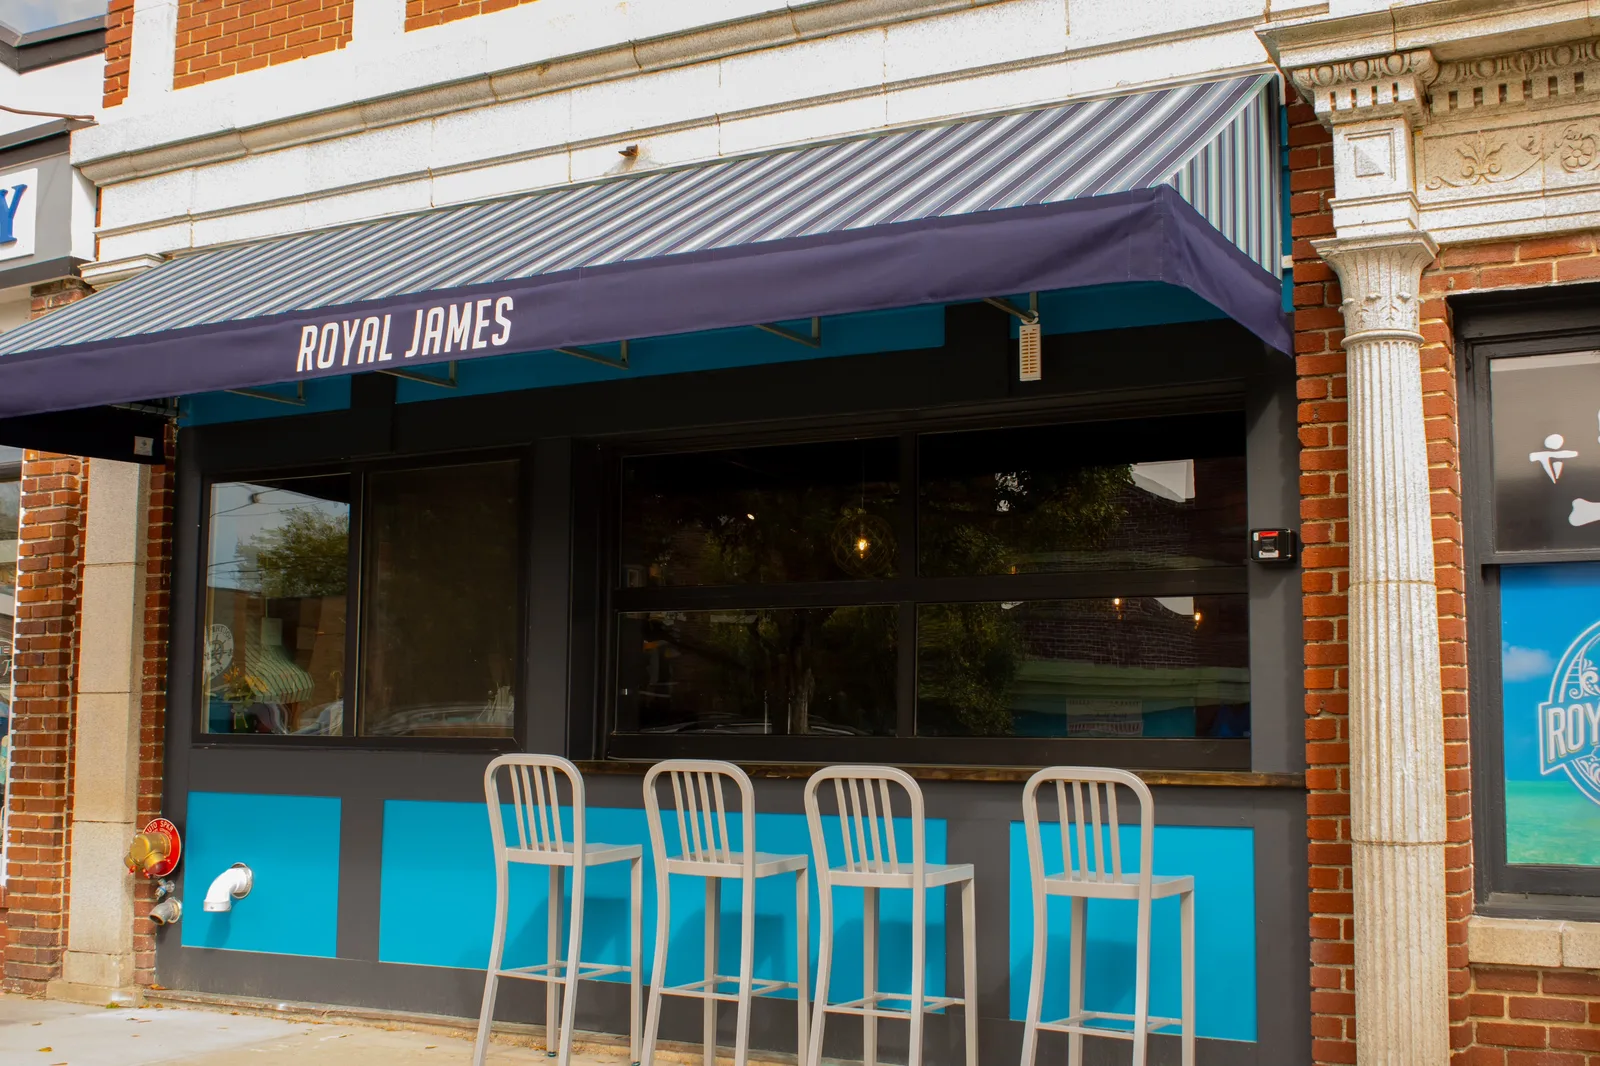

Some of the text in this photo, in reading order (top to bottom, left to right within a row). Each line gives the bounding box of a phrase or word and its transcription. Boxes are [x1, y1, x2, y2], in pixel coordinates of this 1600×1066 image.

[296, 296, 514, 373] ROYAL JAMES
[1547, 702, 1600, 763] ROY
[145, 822, 158, 834] UTO
